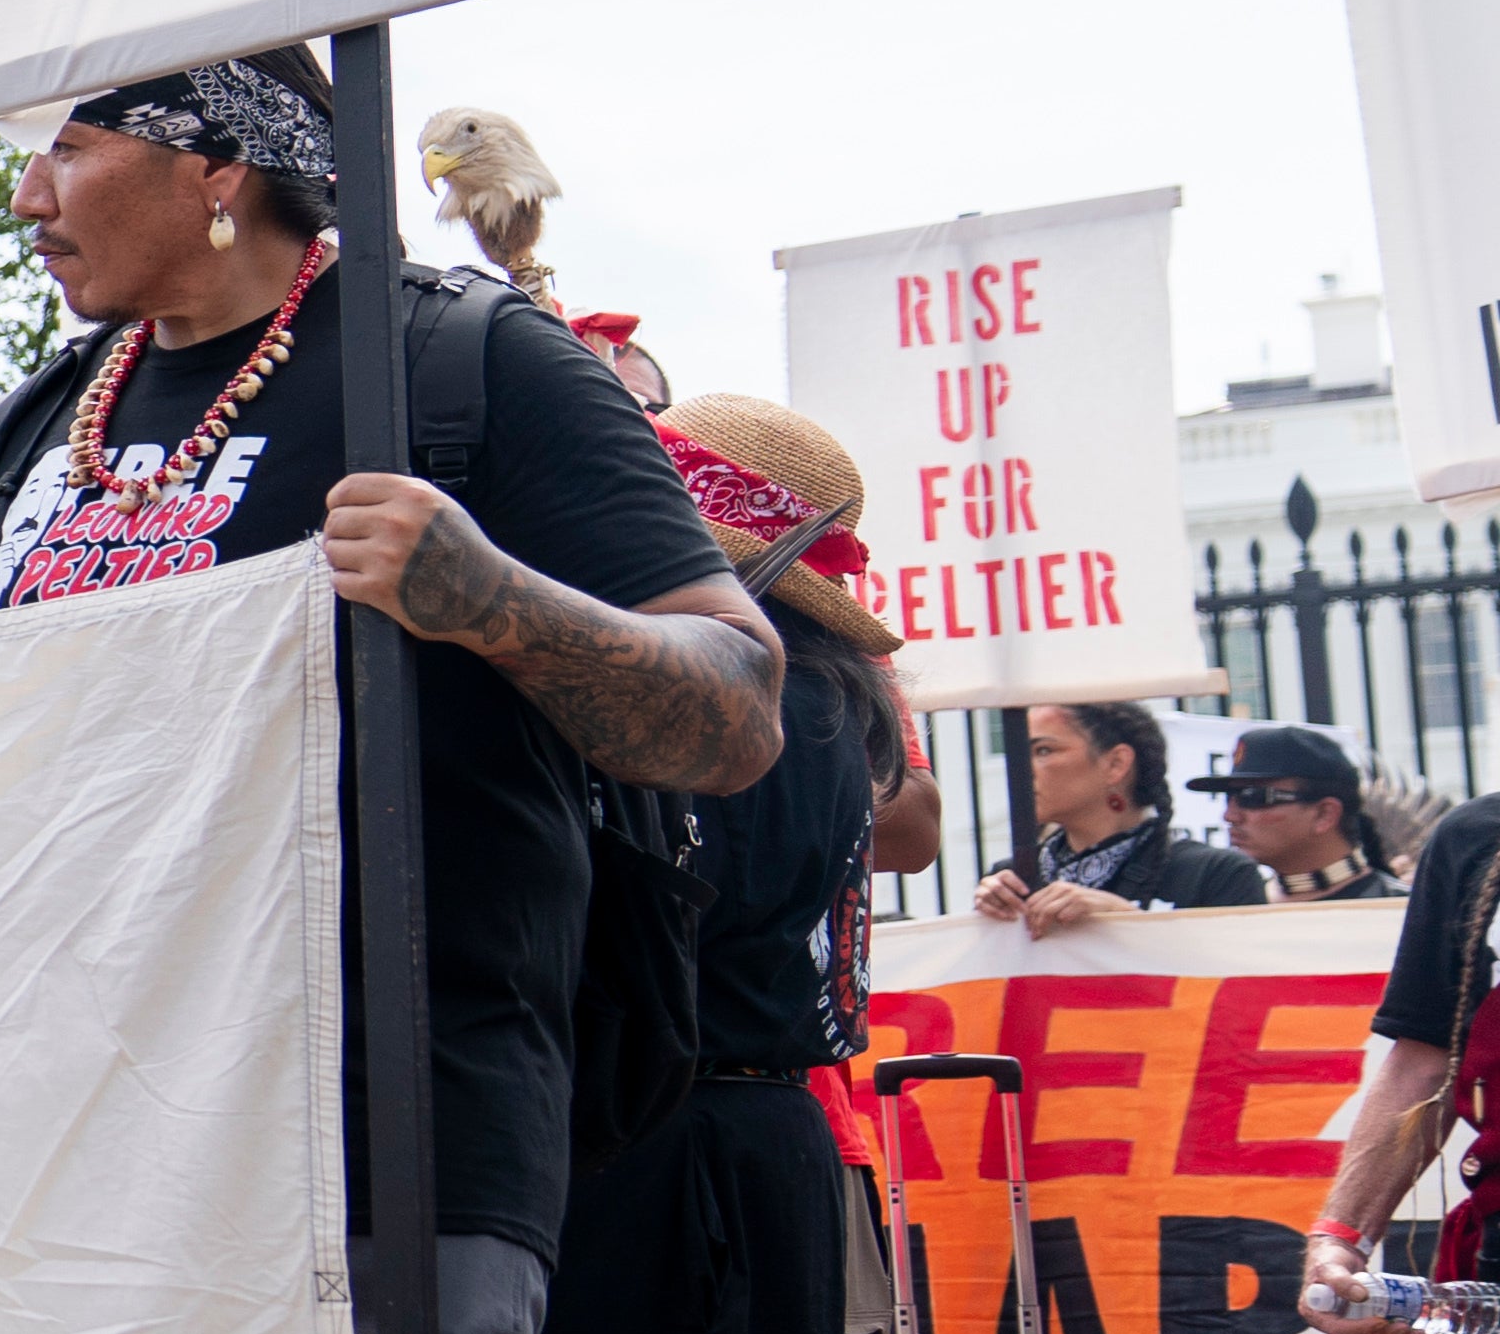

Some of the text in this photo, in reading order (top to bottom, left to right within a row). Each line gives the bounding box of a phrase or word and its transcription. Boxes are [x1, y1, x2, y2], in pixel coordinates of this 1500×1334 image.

[896, 257, 1043, 349] RISE
[935, 360, 1010, 442] UP
[41, 490, 236, 546] LEONARD
[919, 456, 1039, 543] FOR
